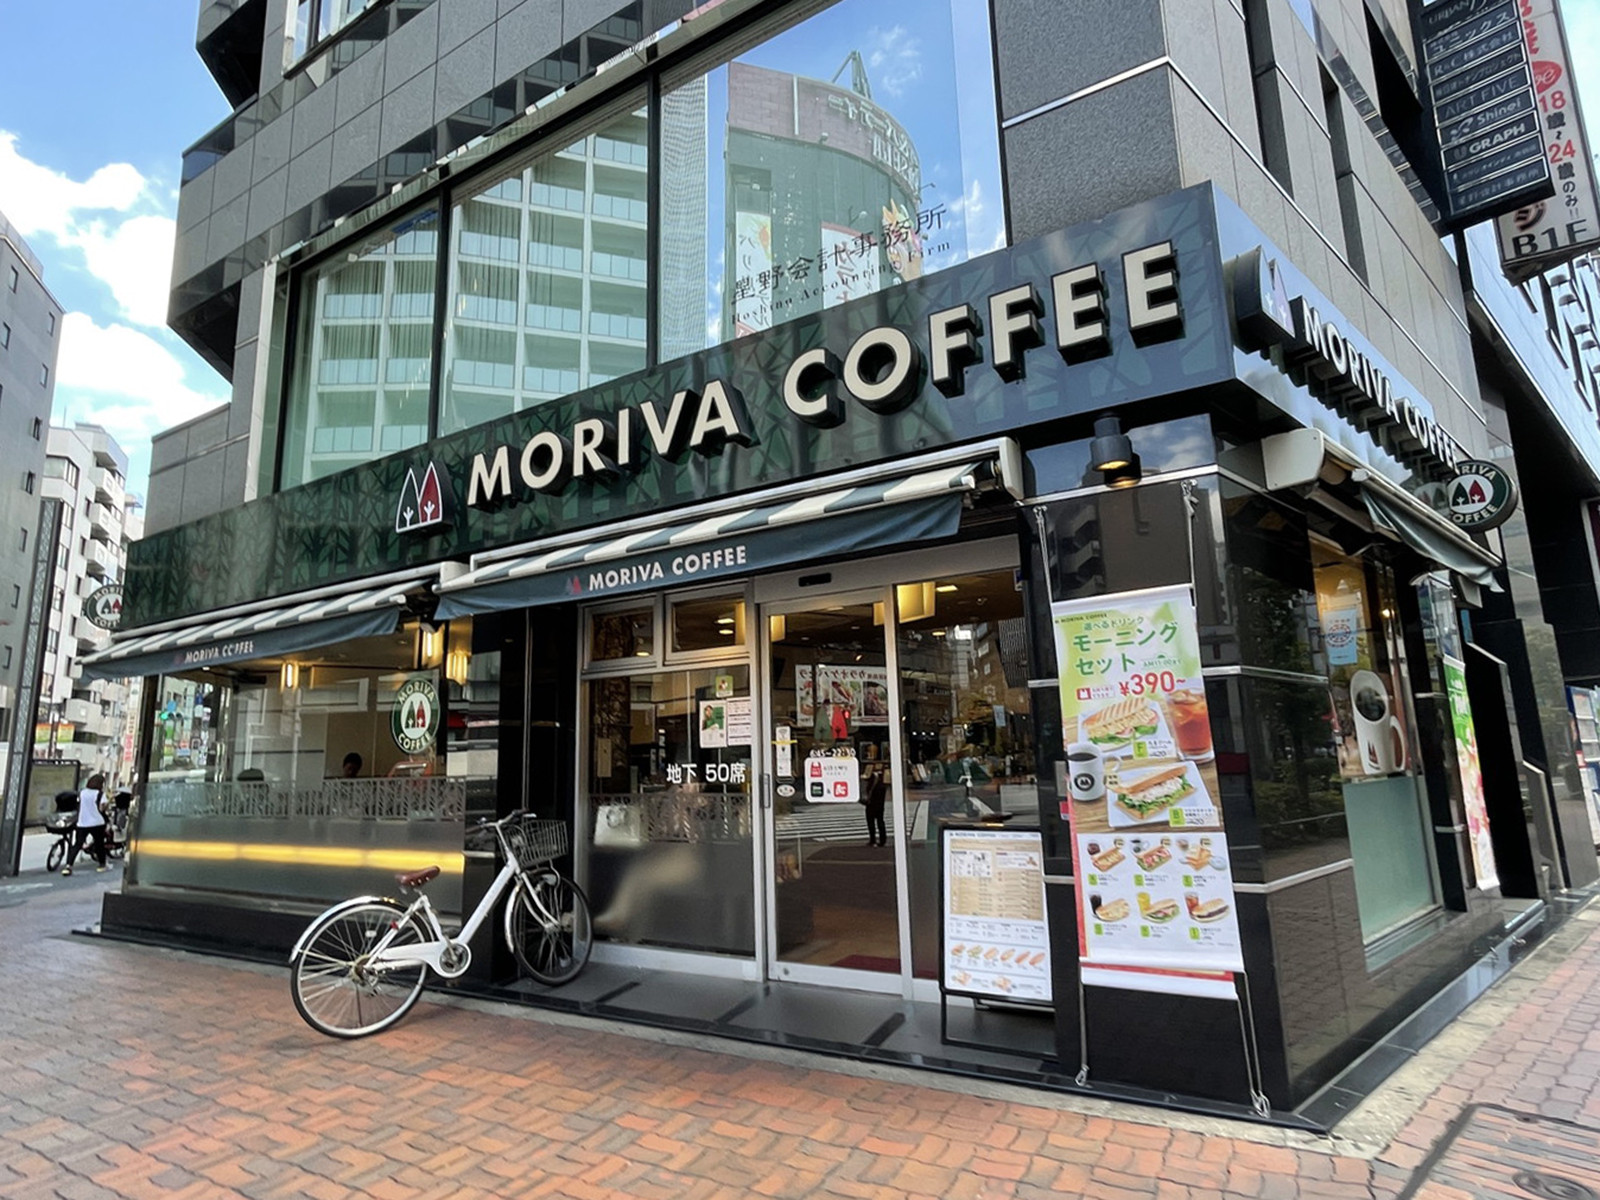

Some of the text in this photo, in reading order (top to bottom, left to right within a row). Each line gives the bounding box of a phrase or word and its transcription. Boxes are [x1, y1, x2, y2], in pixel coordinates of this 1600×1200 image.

[1432, 11, 1510, 54] ユニックス
[1444, 96, 1476, 119] ART
[1480, 75, 1518, 103] FIVE
[1469, 122, 1525, 154] GRAPH
[1511, 218, 1588, 258] B1F
[467, 240, 1181, 506] MORIVA COFFEE
[1302, 297, 1460, 475] MORIVA COFFEE
[1450, 503, 1498, 524] OFFEE
[589, 545, 747, 592] MORIVA COFFEE
[1073, 621, 1179, 652] モーニング
[185, 646, 219, 664] MORIVA
[1075, 652, 1136, 676] セット
[398, 681, 435, 704] MORIVA
[666, 762, 746, 785] 地下 50席
